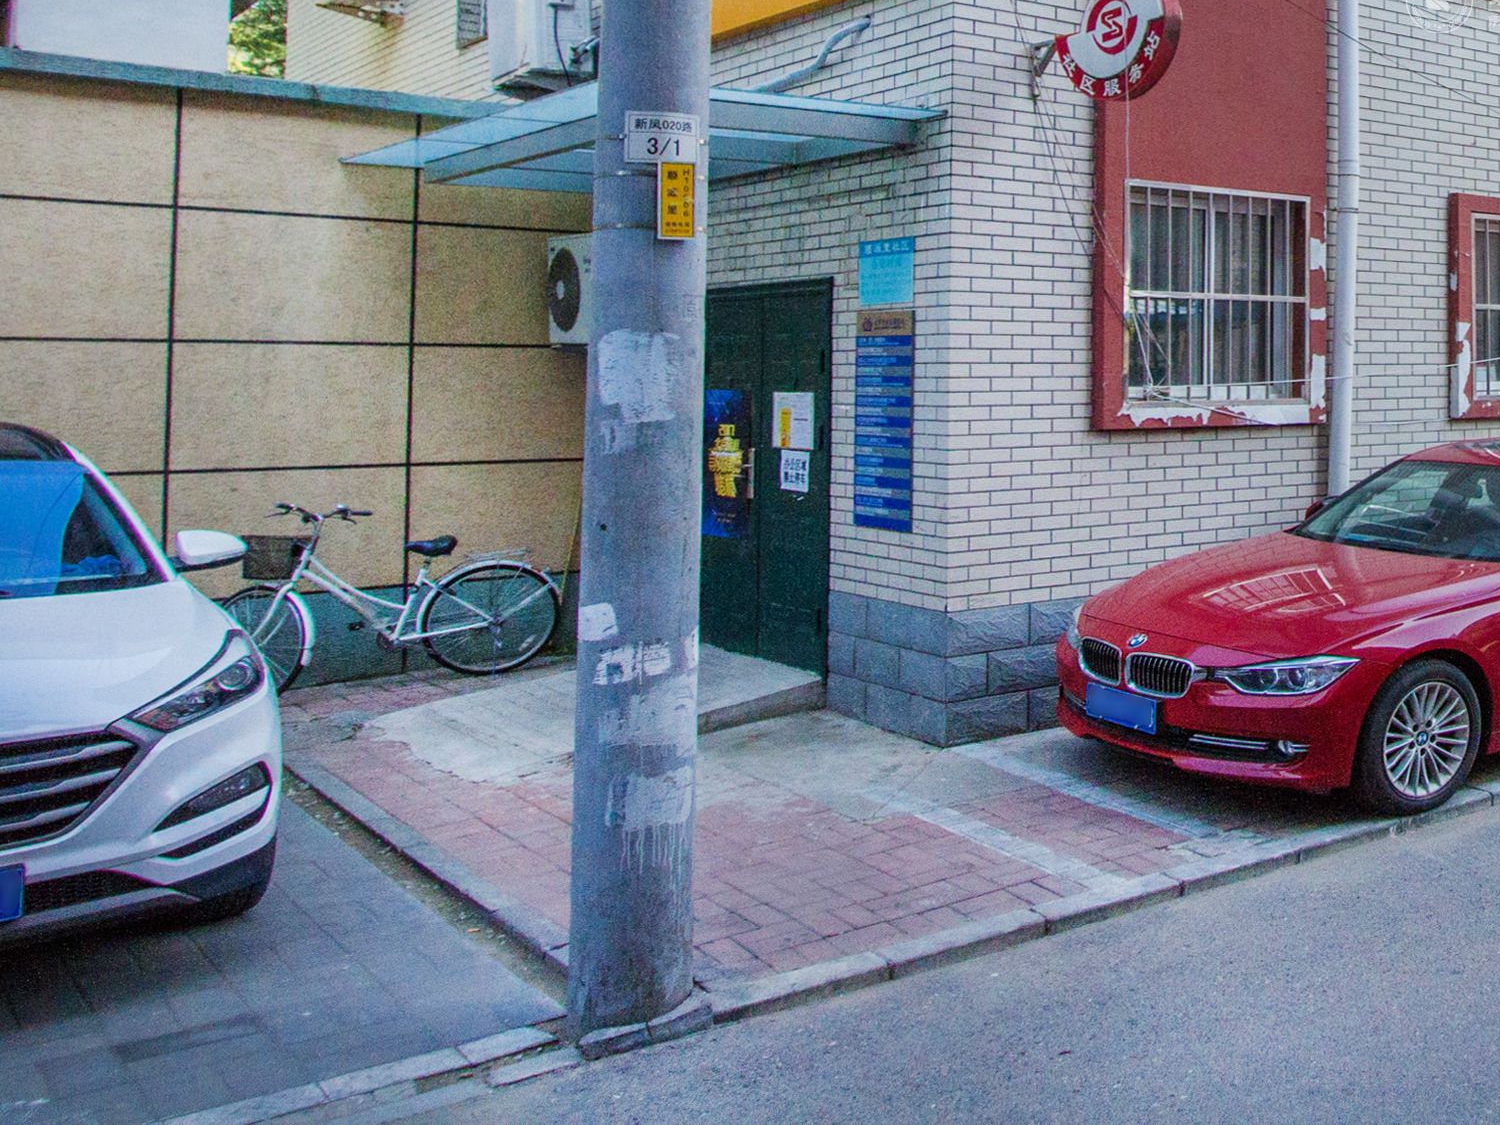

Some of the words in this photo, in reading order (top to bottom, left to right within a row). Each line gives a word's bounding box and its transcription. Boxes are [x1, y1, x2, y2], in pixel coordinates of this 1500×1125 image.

[1062, 30, 1161, 97] 社区服务站
[646, 137, 680, 156] 3/1
